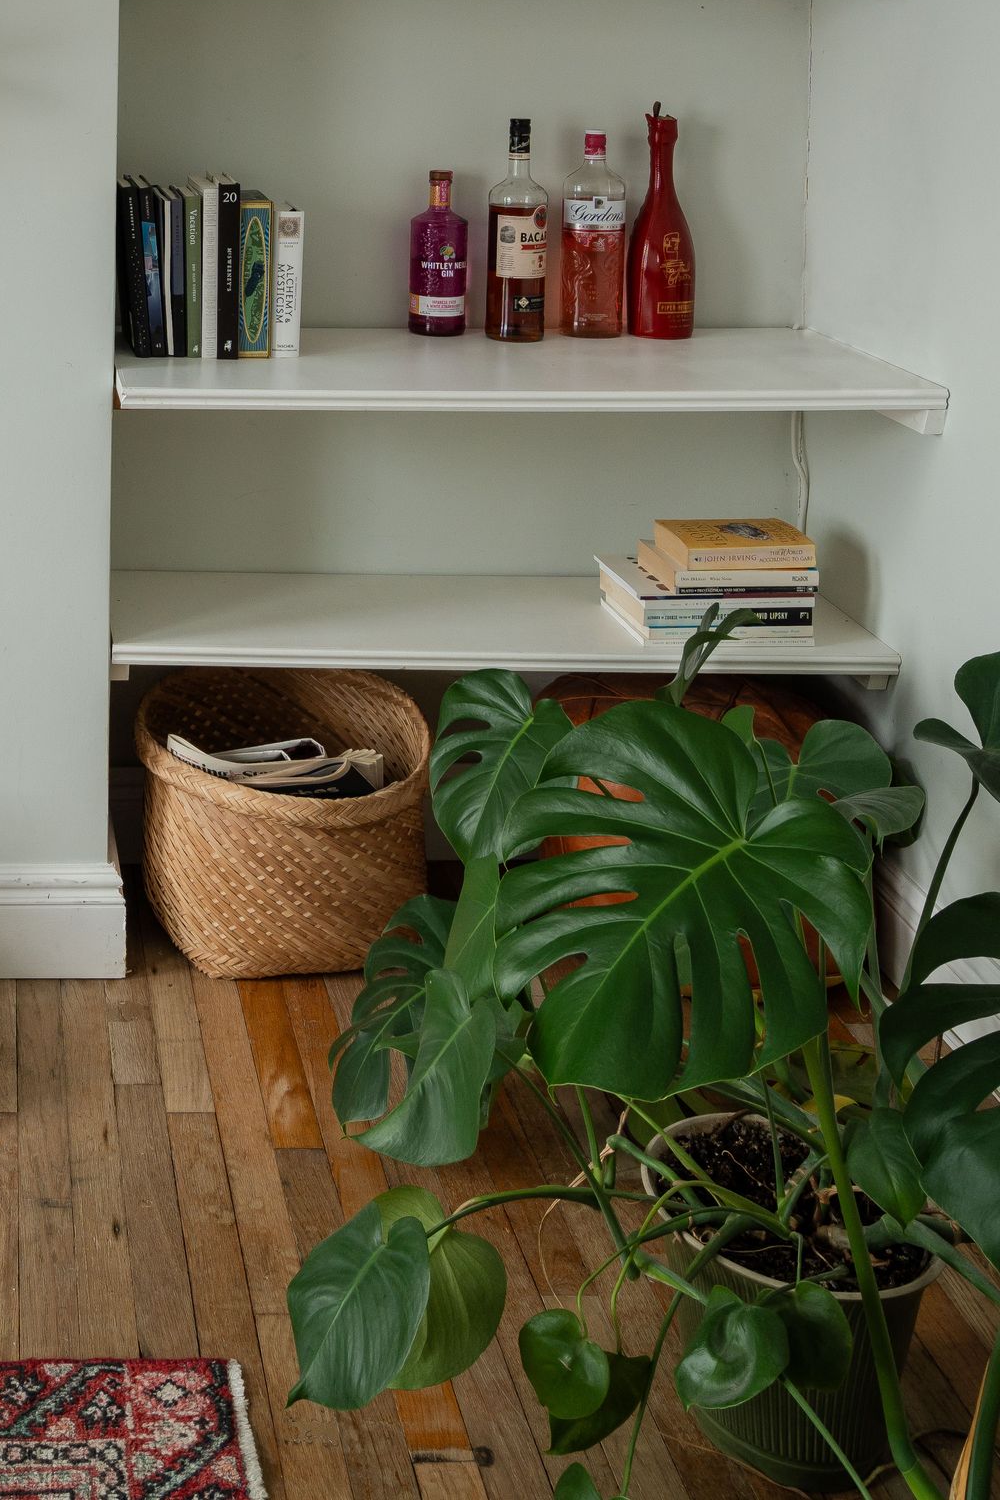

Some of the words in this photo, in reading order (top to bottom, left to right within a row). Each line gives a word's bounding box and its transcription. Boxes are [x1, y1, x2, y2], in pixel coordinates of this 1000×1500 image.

[222, 192, 238, 203] 20
[189, 209, 198, 245] Vacation
[421, 261, 453, 270] WHITLEY
[441, 270, 454, 278] GIN
[275, 263, 284, 323] MYSTICISM
[285, 264, 294, 317] ALCHEMY
[704, 555, 726, 563] JOHN
[728, 554, 757, 562] IRVING
[769, 612, 788, 620] LIPSKY
